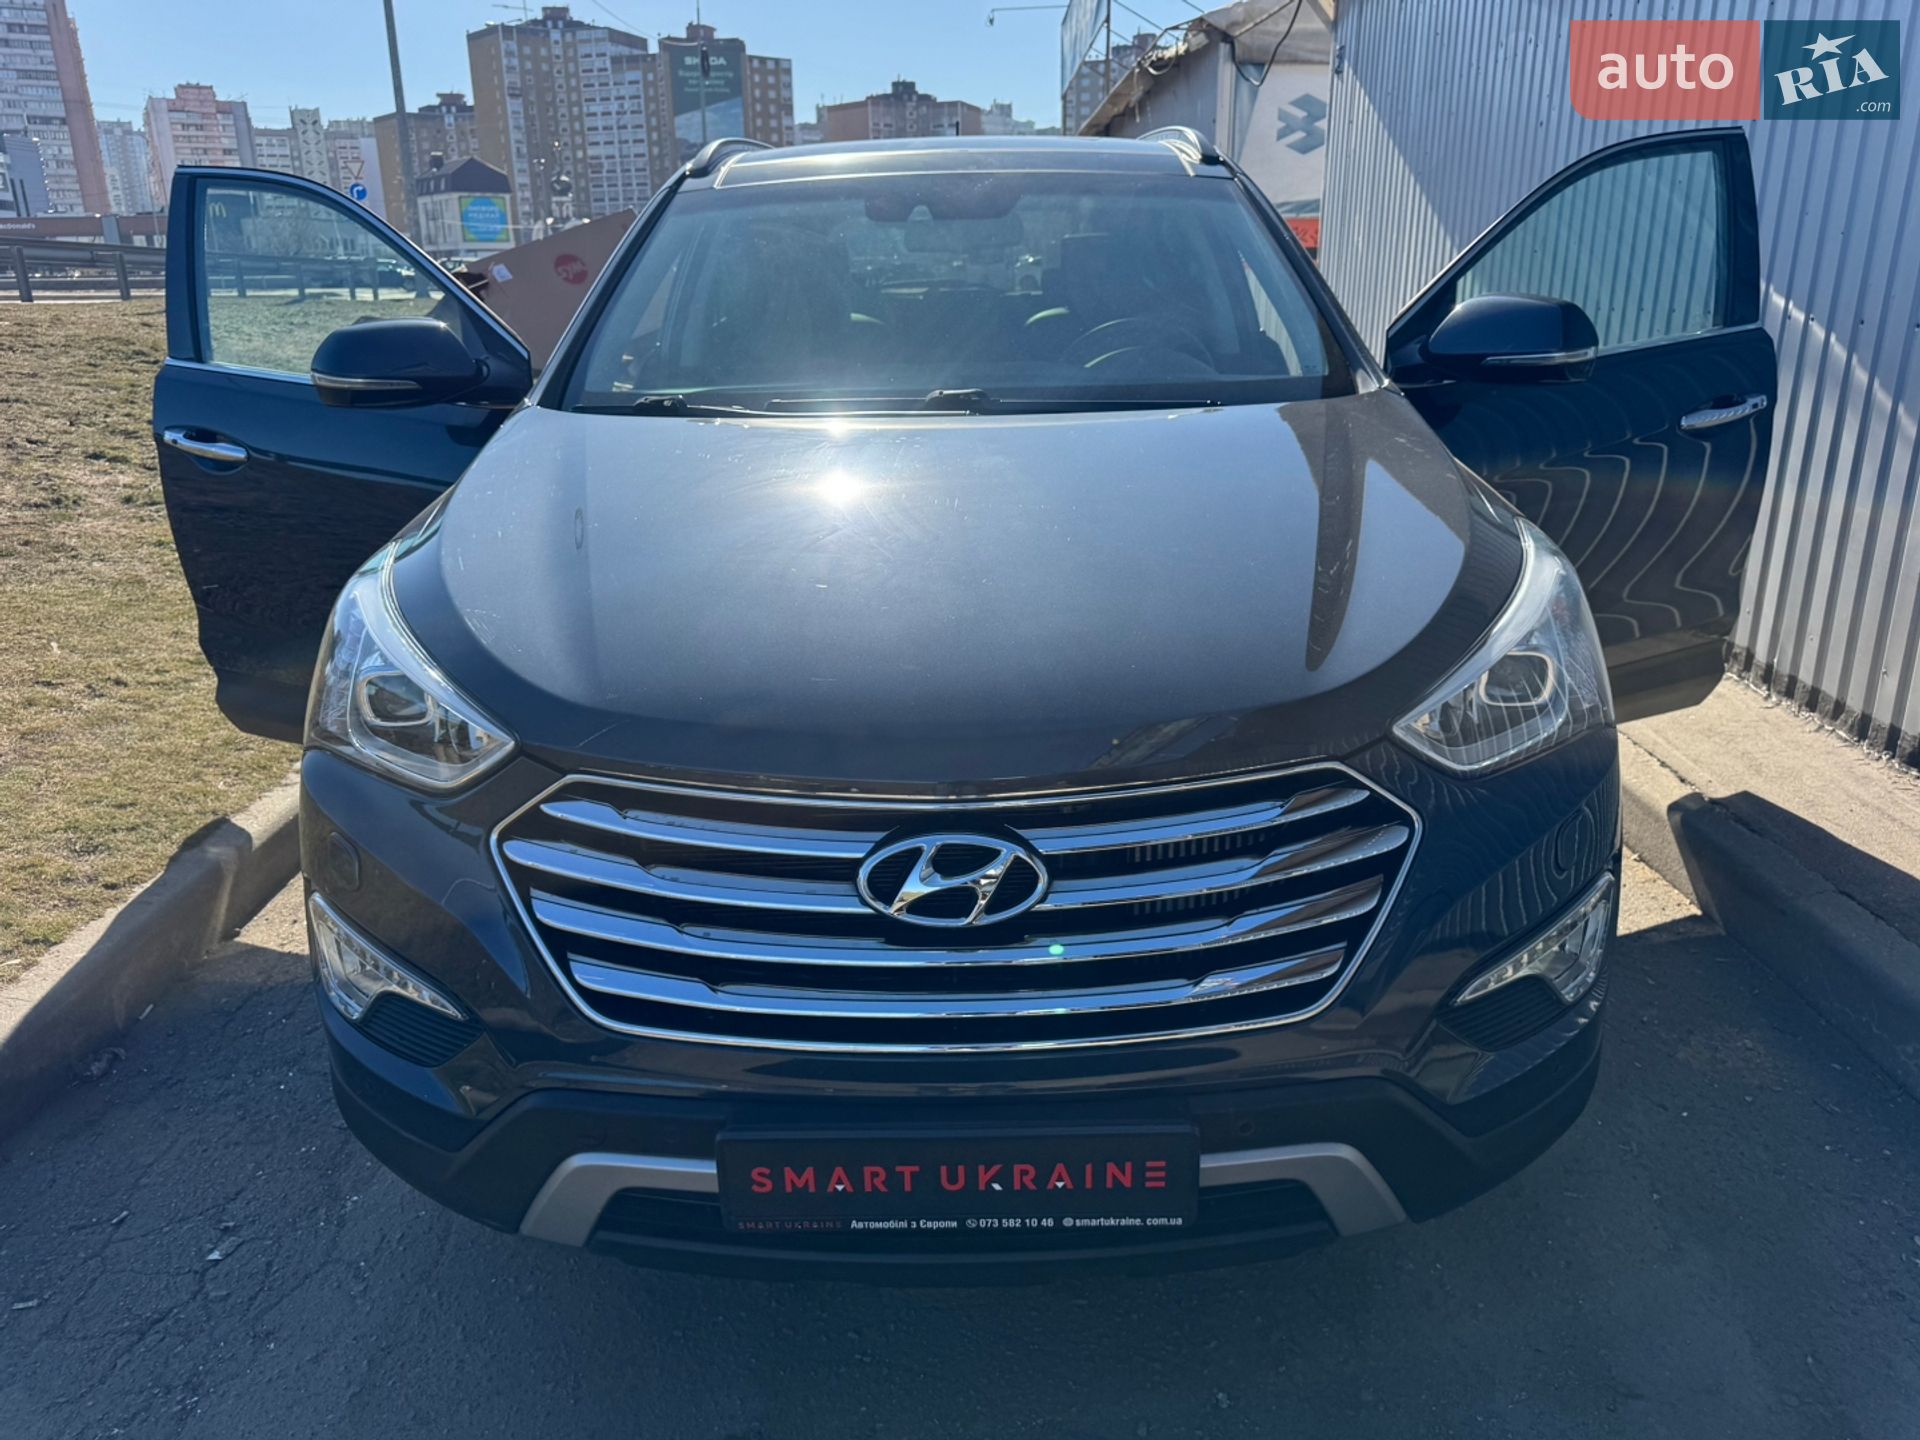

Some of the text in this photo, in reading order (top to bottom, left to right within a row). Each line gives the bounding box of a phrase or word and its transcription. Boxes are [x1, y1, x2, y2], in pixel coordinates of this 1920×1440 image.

[751, 1160, 1167, 1193] SMART UKRAINE
[850, 1219, 958, 1231] Автомобілі з Європи
[979, 1218, 999, 1228] 073
[1025, 1217, 1038, 1227] 10
[1041, 1217, 1054, 1227] 46
